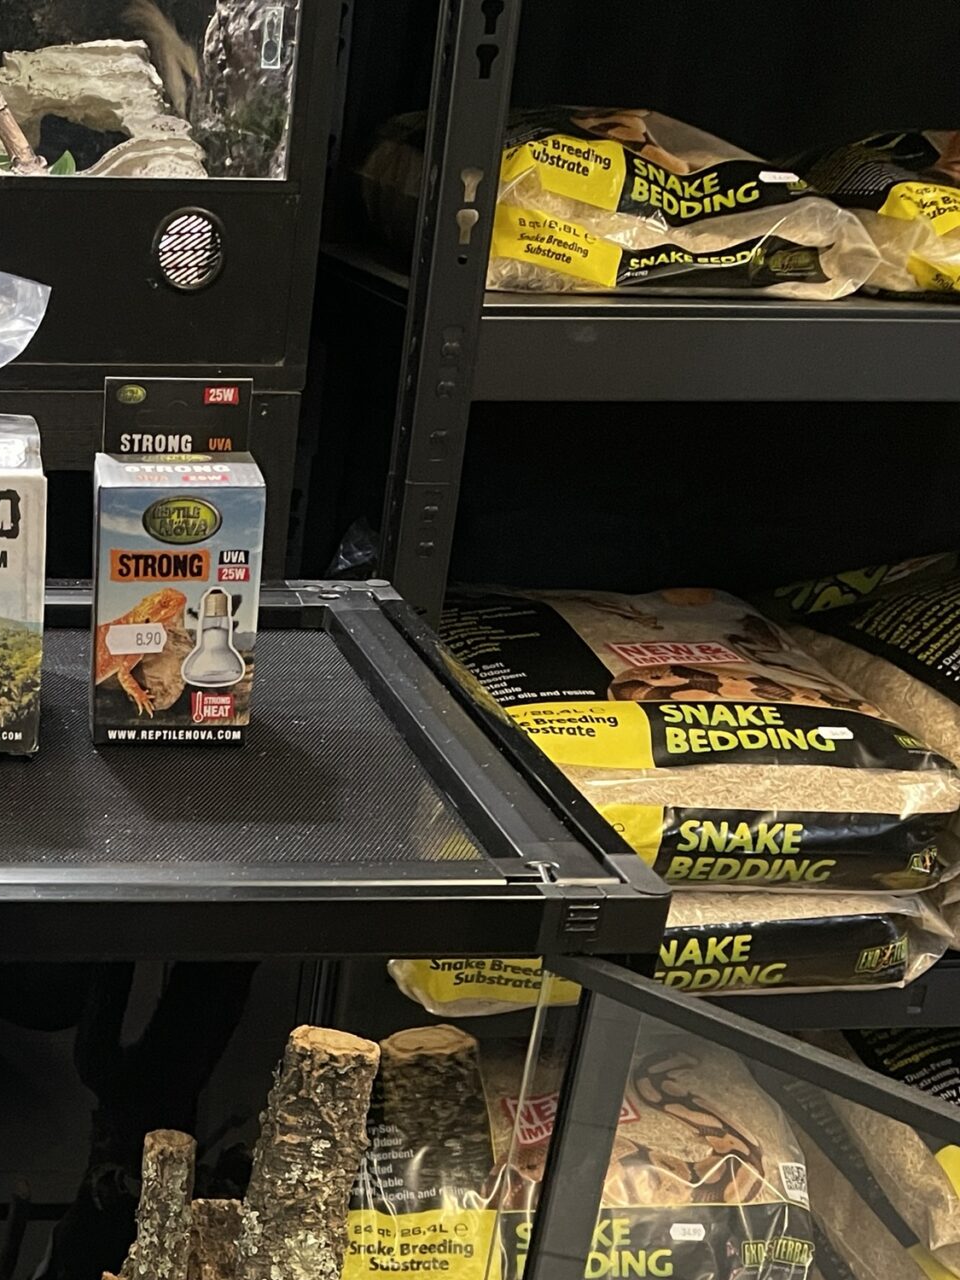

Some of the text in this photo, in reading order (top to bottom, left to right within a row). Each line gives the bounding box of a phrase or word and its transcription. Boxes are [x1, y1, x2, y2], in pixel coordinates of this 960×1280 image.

[530, 148, 590, 177] ubstrate
[551, 139, 612, 170] Breeding
[632, 157, 720, 199] SNAKE
[630, 175, 760, 219] BEDDING
[524, 243, 572, 264] Substrate
[546, 234, 589, 259] Breeding
[628, 250, 693, 271] SNAKE
[208, 387, 235, 402] 25W
[120, 433, 232, 453] STRONG UVA
[124, 464, 231, 473] STRONG
[153, 506, 201, 520] REPTILE
[159, 518, 209, 537] NOVA
[118, 553, 203, 578] STRONG
[223, 551, 245, 563] UVA
[221, 568, 246, 580] 25W
[135, 631, 162, 647] 8.90
[616, 643, 695, 657] NEW
[479, 668, 512, 678] Odour
[203, 705, 231, 718] HEAT
[533, 715, 619, 727] Breeding
[658, 704, 785, 728] SNAKE
[107, 729, 242, 741] WWW.REPTILENOVA.COM
[525, 725, 596, 738] bstrate
[664, 726, 837, 755] BEDDING
[676, 819, 804, 855] SNAKE
[663, 855, 837, 883] BEDDING
[658, 934, 753, 967] NAKE
[429, 958, 486, 971] Snake
[453, 971, 543, 990] Substrate
[417, 1188, 436, 1200] and
[349, 1239, 475, 1258] Snake Breeding
[368, 1257, 450, 1272] Substrate
